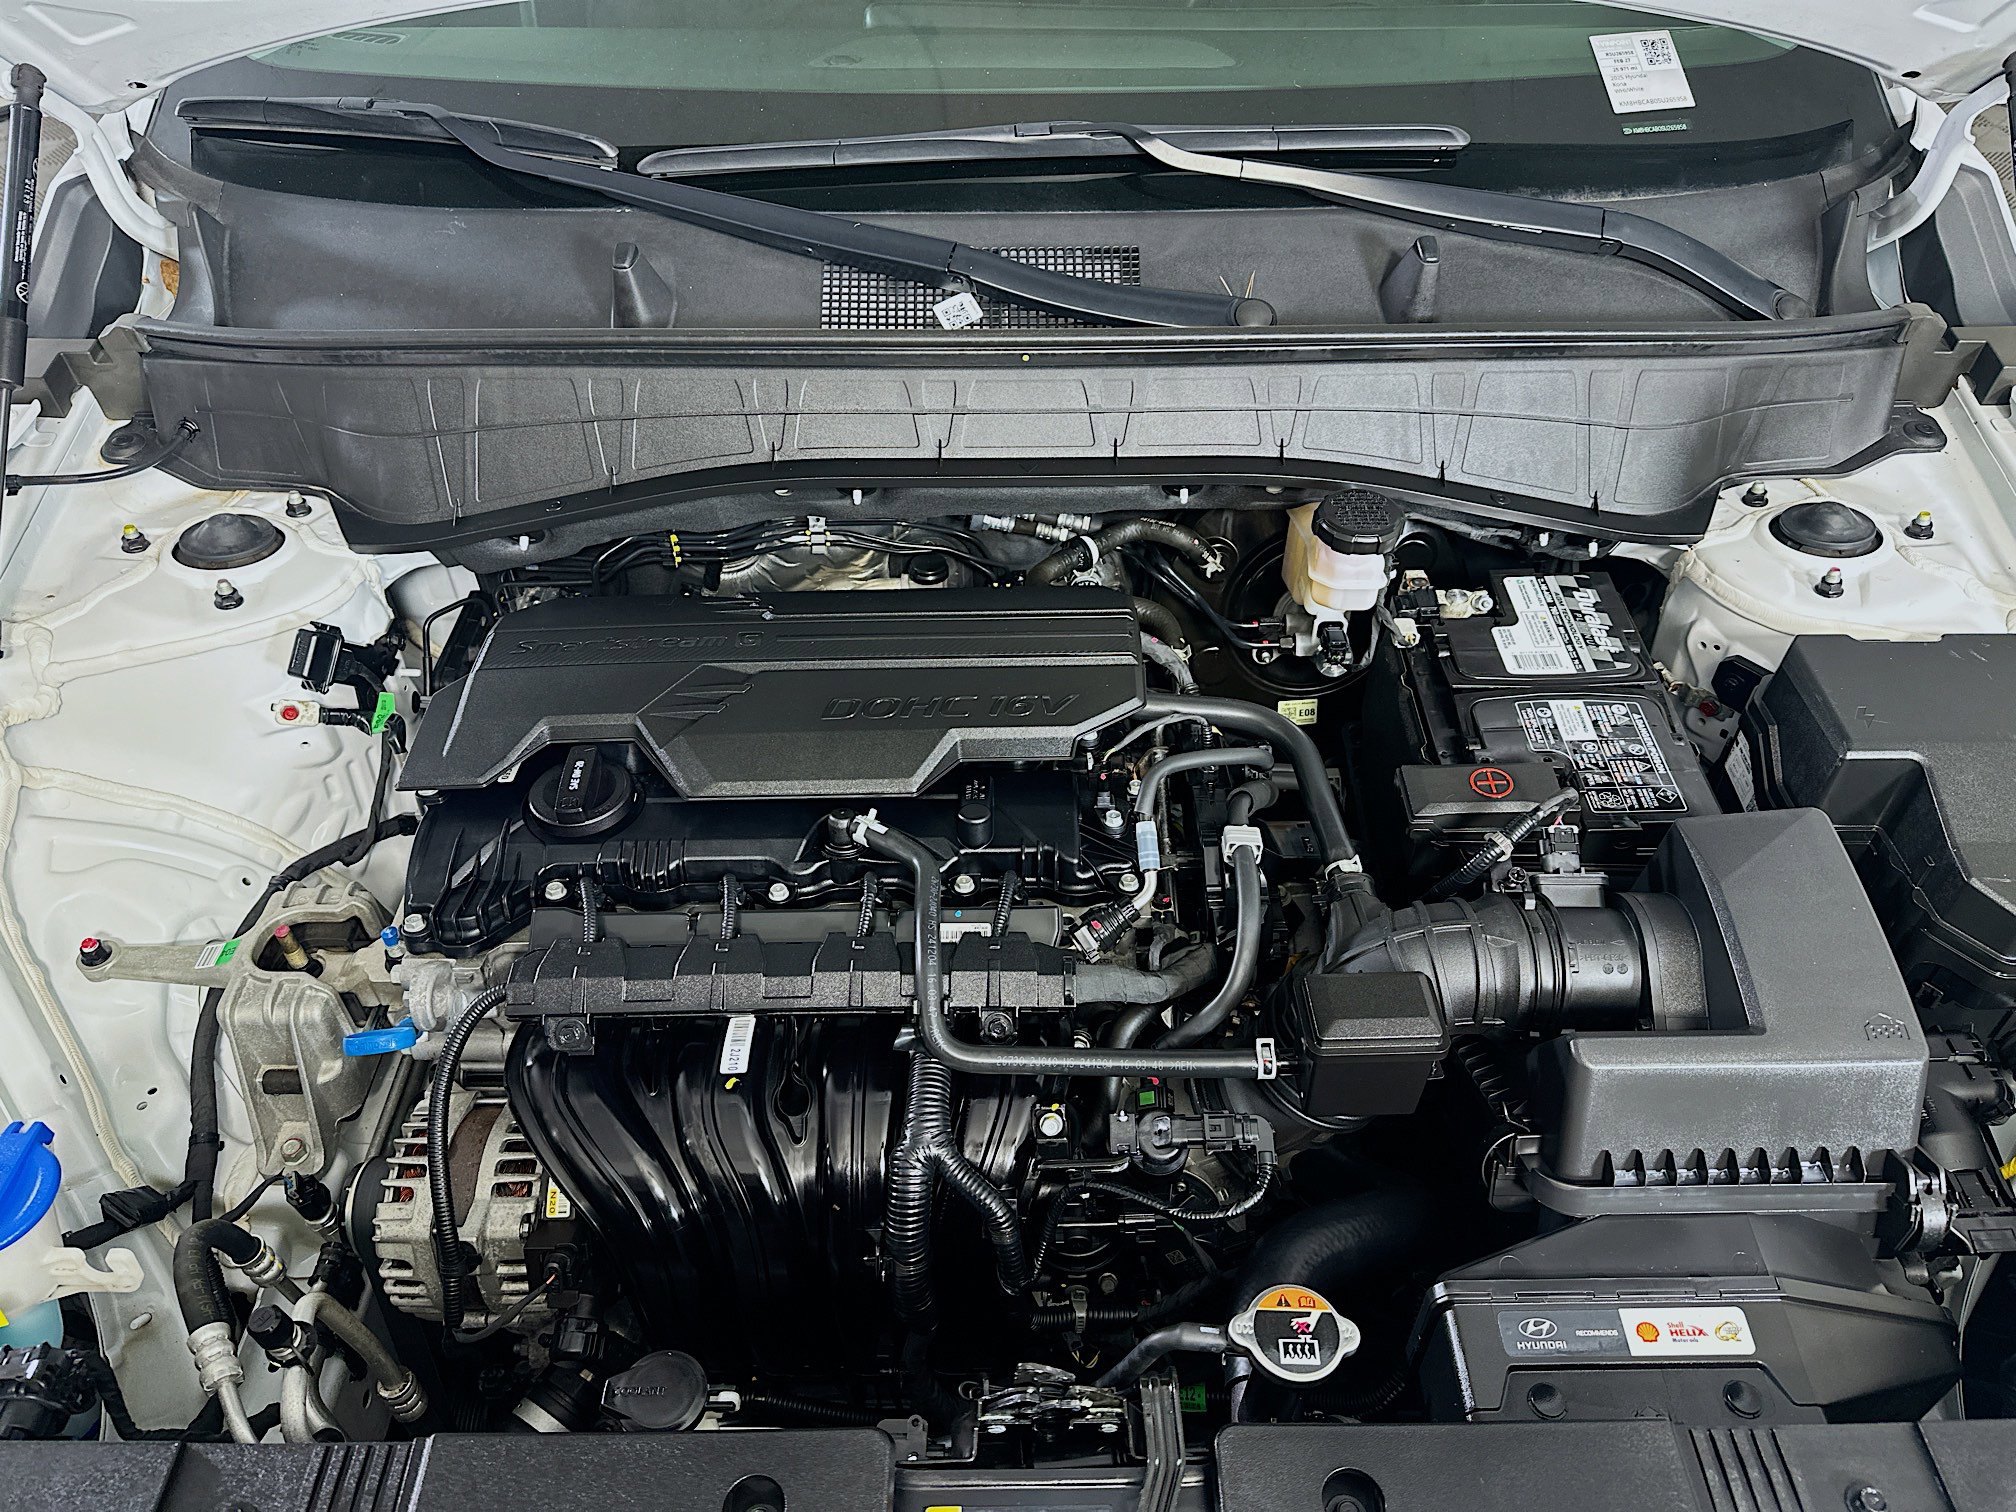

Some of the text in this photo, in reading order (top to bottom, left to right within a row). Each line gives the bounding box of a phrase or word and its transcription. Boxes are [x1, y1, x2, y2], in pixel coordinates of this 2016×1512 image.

[1553, 591, 1564, 606] AGM
[1561, 608, 1584, 649] TECHNOLOGY
[1573, 588, 1619, 653] Duralast
[821, 693, 1080, 720] DOHC 16V
[1299, 708, 1316, 717] E08
[568, 778, 580, 790] SAE
[927, 934, 937, 965] 241204
[728, 1048, 740, 1071] 2J210
[1667, 1321, 1684, 1329] Shell
[1576, 1329, 1618, 1337] RECOMMENDS
[1669, 1328, 1708, 1336] HELIX
[1517, 1341, 1567, 1350] HYUNDAI
